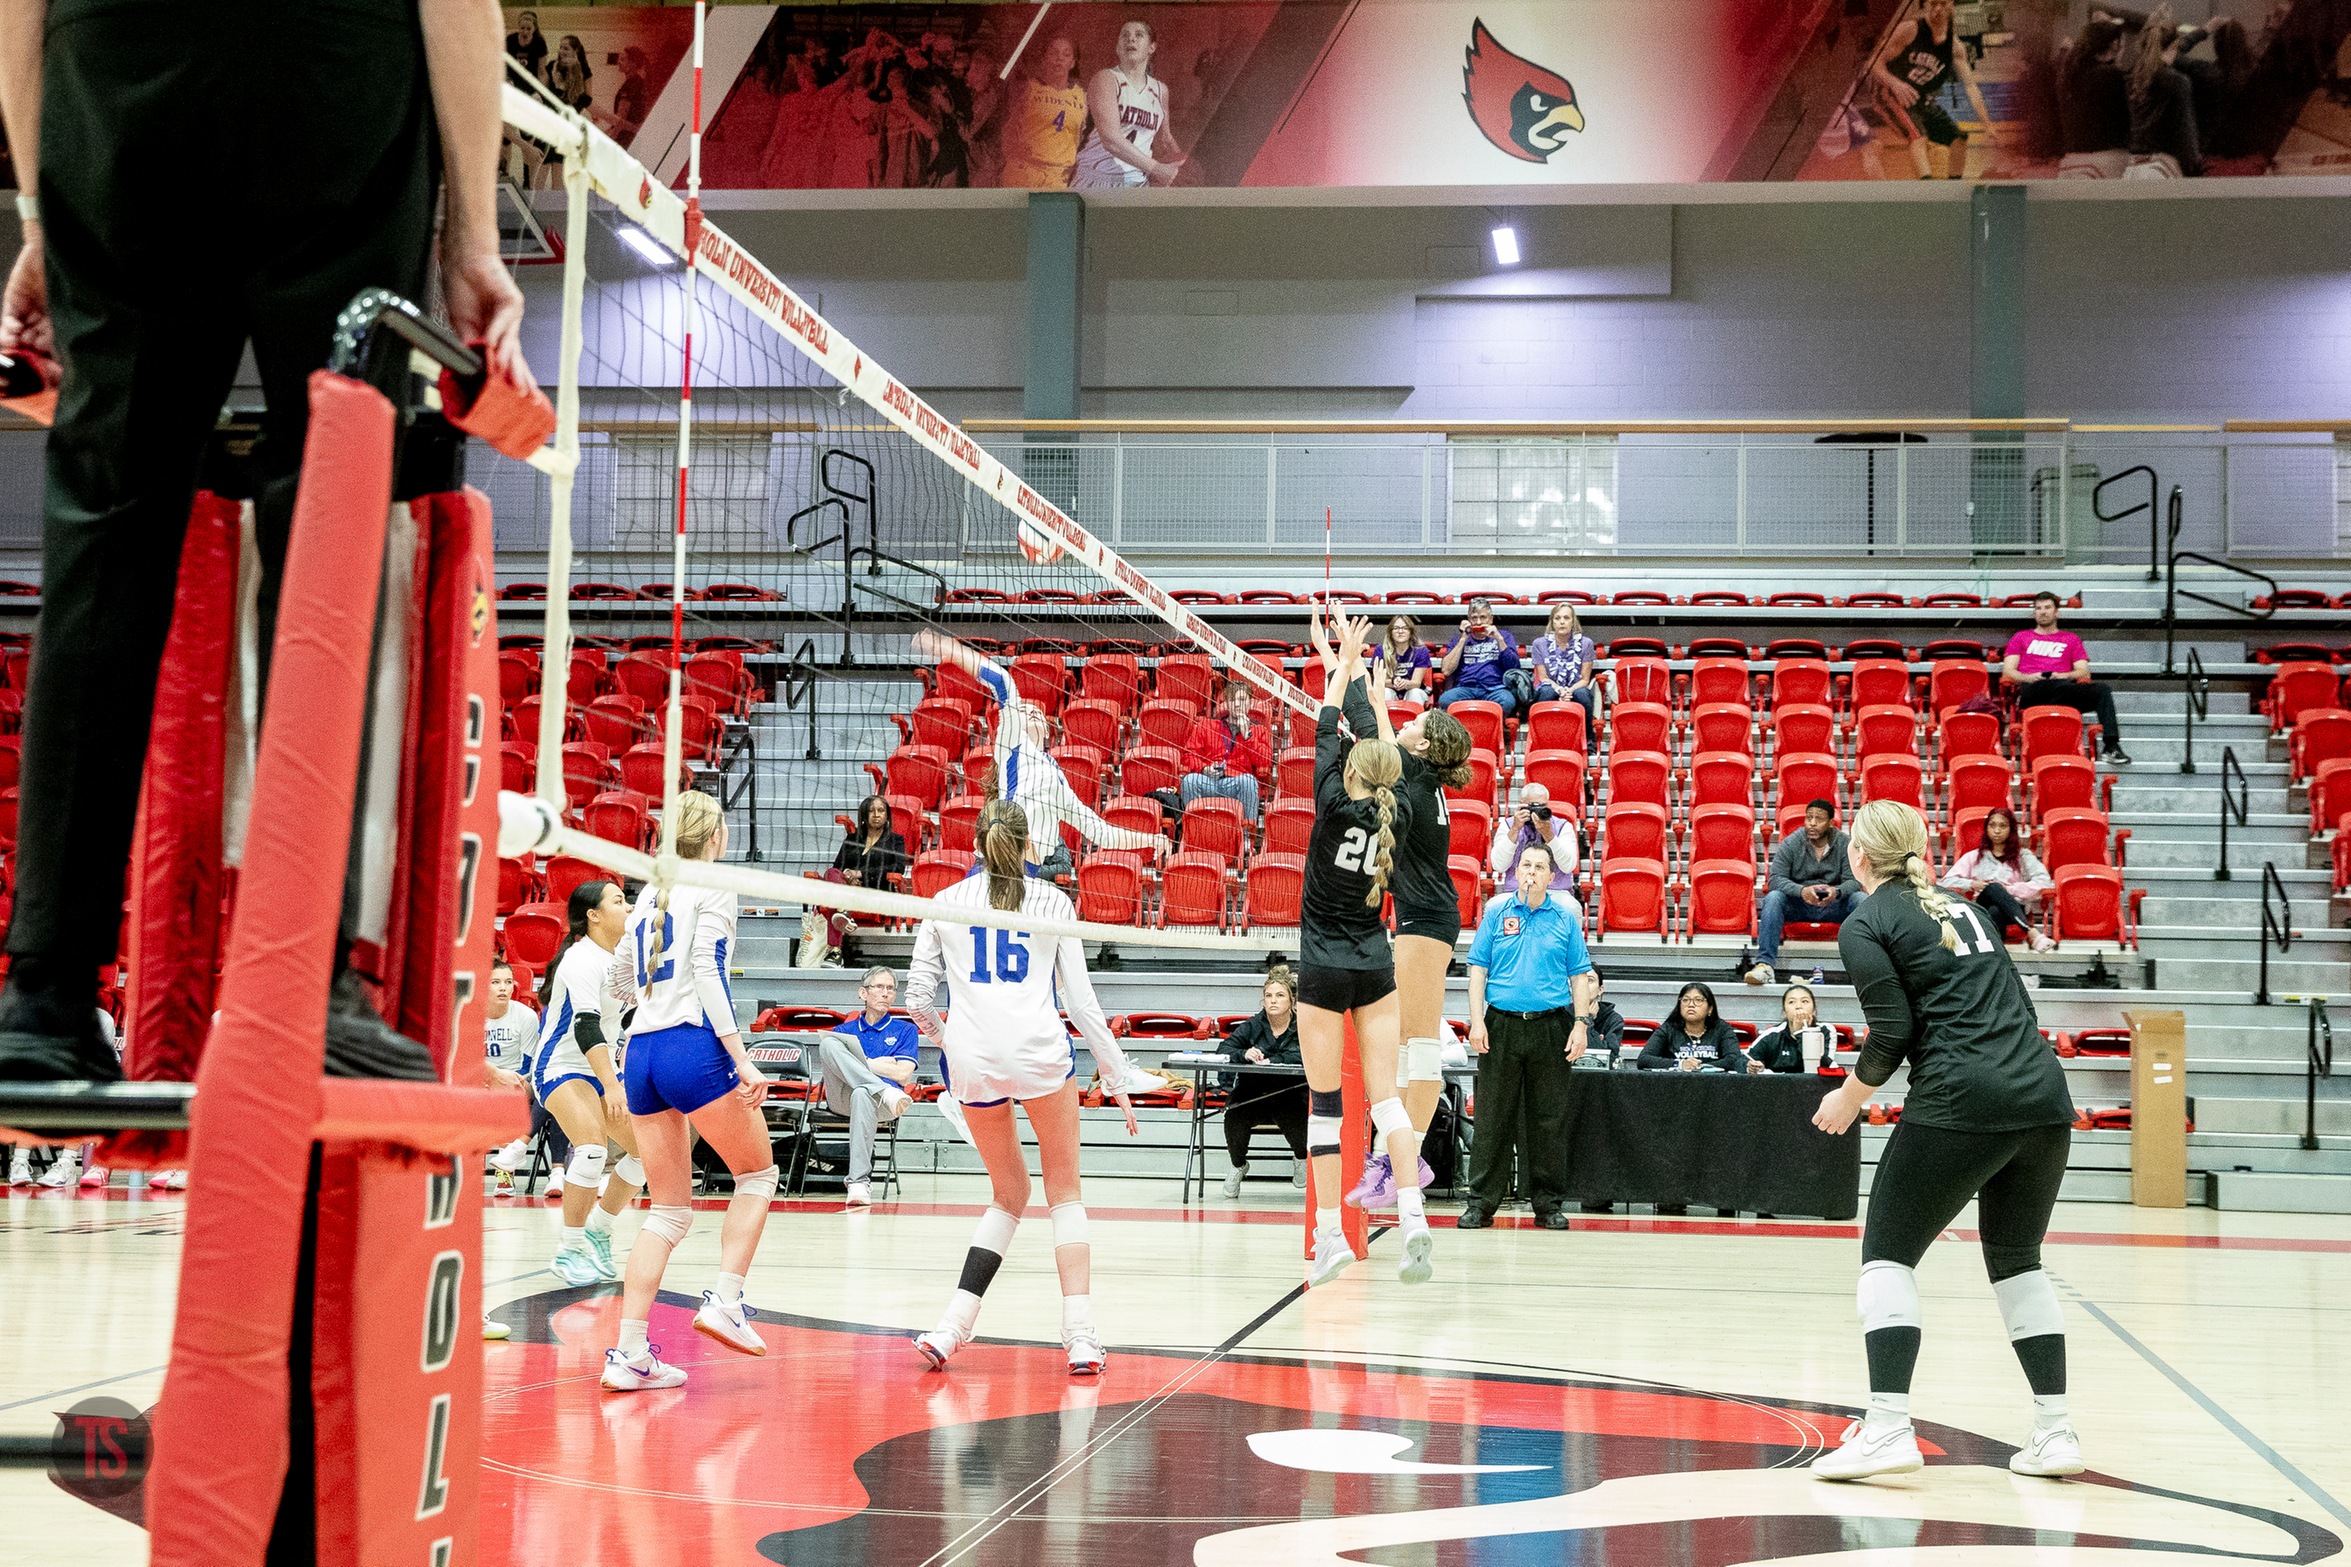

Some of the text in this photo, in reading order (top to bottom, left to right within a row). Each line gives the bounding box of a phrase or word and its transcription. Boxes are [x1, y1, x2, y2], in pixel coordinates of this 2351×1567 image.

[1053, 110, 1065, 132] 4
[2026, 639, 2068, 658] NIKE
[635, 911, 675, 988] 12
[969, 926, 1030, 984] 16
[748, 1048, 801, 1061] CATHOLIC
